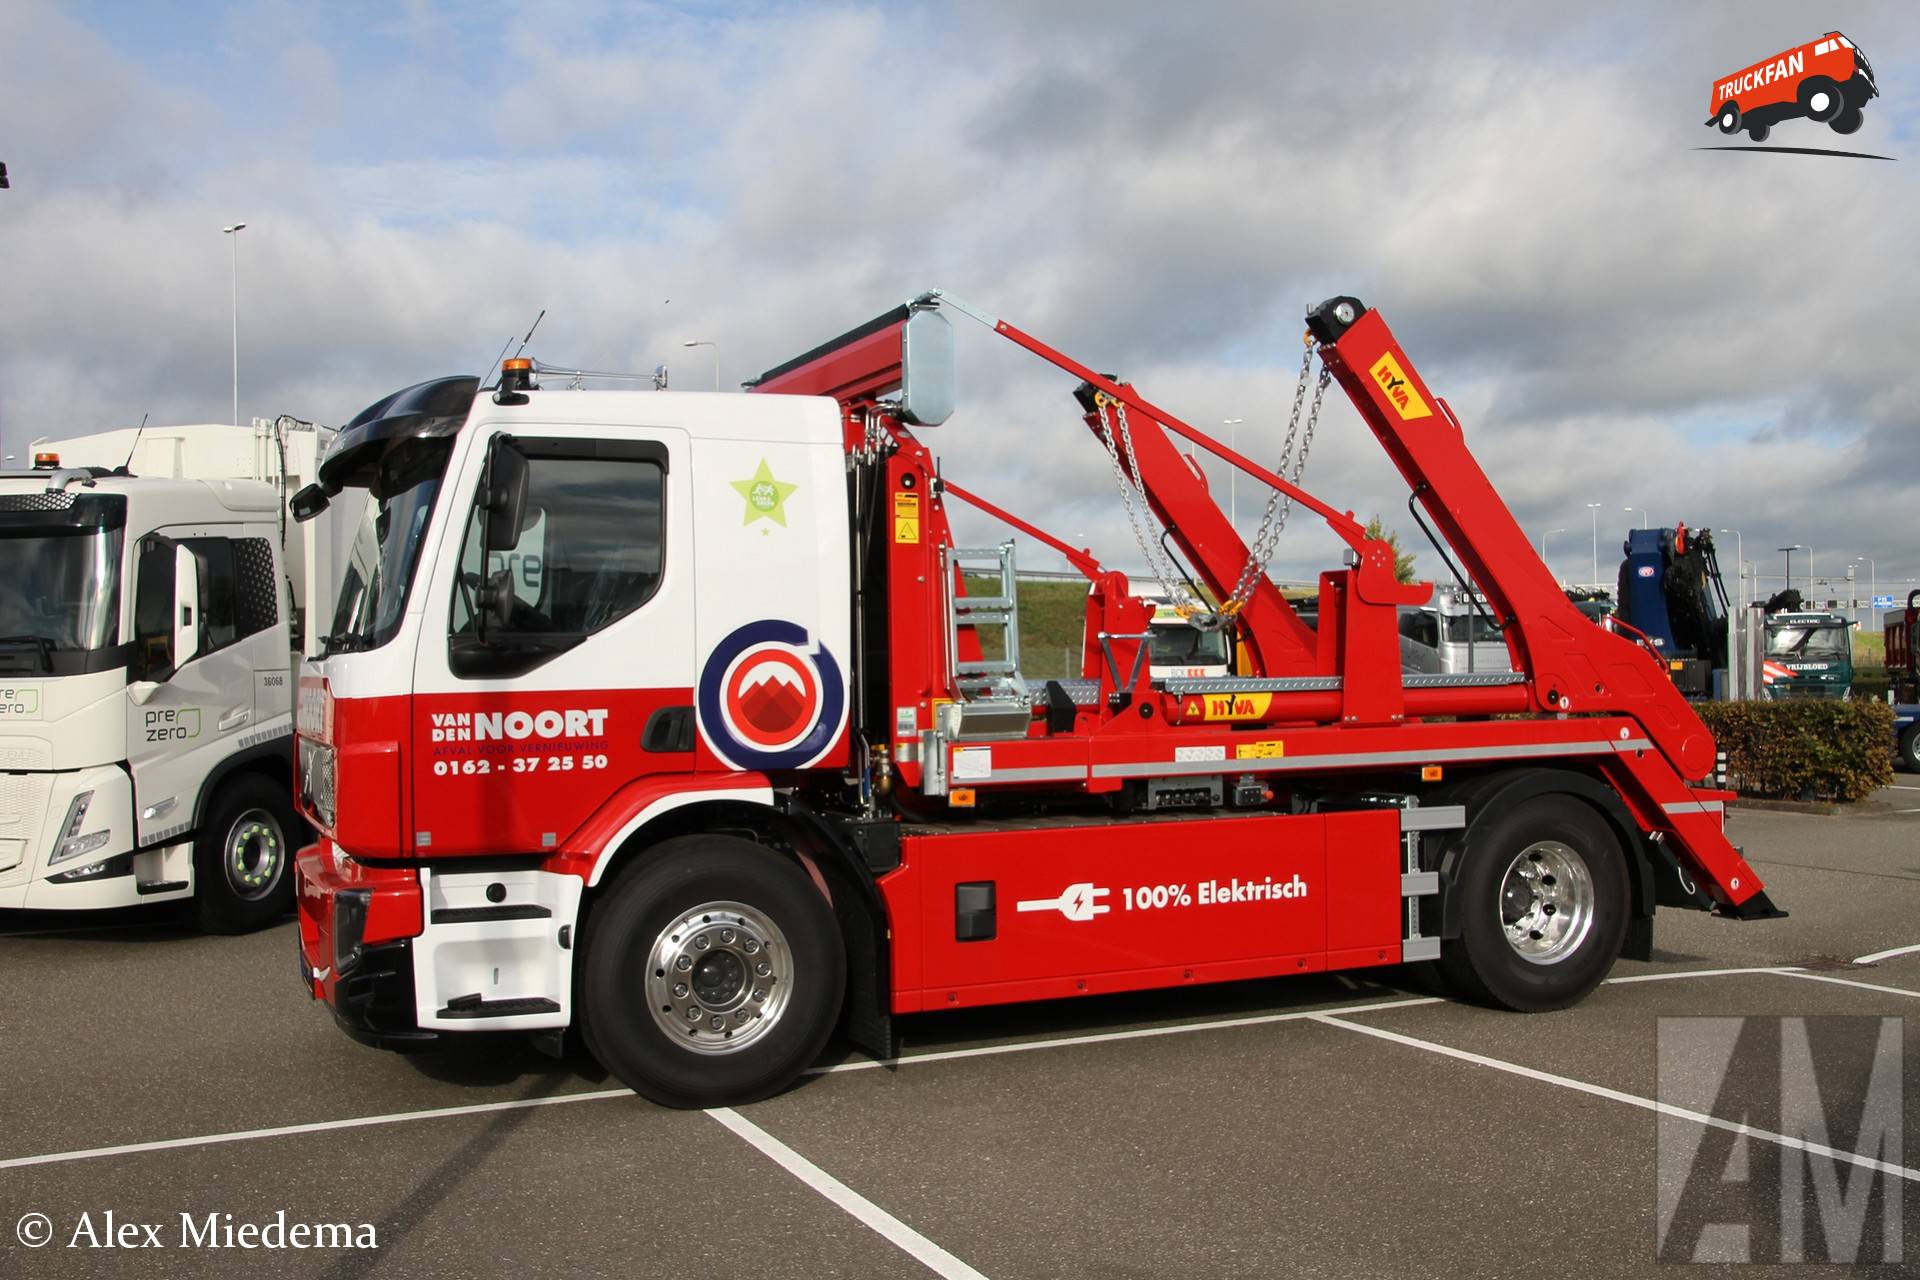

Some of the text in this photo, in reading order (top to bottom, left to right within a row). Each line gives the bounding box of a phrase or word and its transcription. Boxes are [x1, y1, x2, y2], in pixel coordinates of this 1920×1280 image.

[1377, 365, 1408, 410] HYVA
[1786, 663, 1829, 671] VRIJBLOED
[264, 676, 283, 687] 36068
[0, 689, 15, 699] re
[0, 703, 25, 714] ero
[1212, 694, 1255, 716] HYVA
[145, 709, 176, 727] pre
[432, 708, 609, 741] VAN NOORT
[146, 726, 187, 742] zero
[432, 728, 471, 742] DEN
[433, 740, 609, 757] AFVAL VOOR VERNIEUWING
[433, 760, 491, 776] 0162
[512, 758, 541, 773] 37
[547, 756, 574, 771] 25
[582, 754, 608, 770] 50
[1123, 874, 1308, 911] 100% Elektrisch
